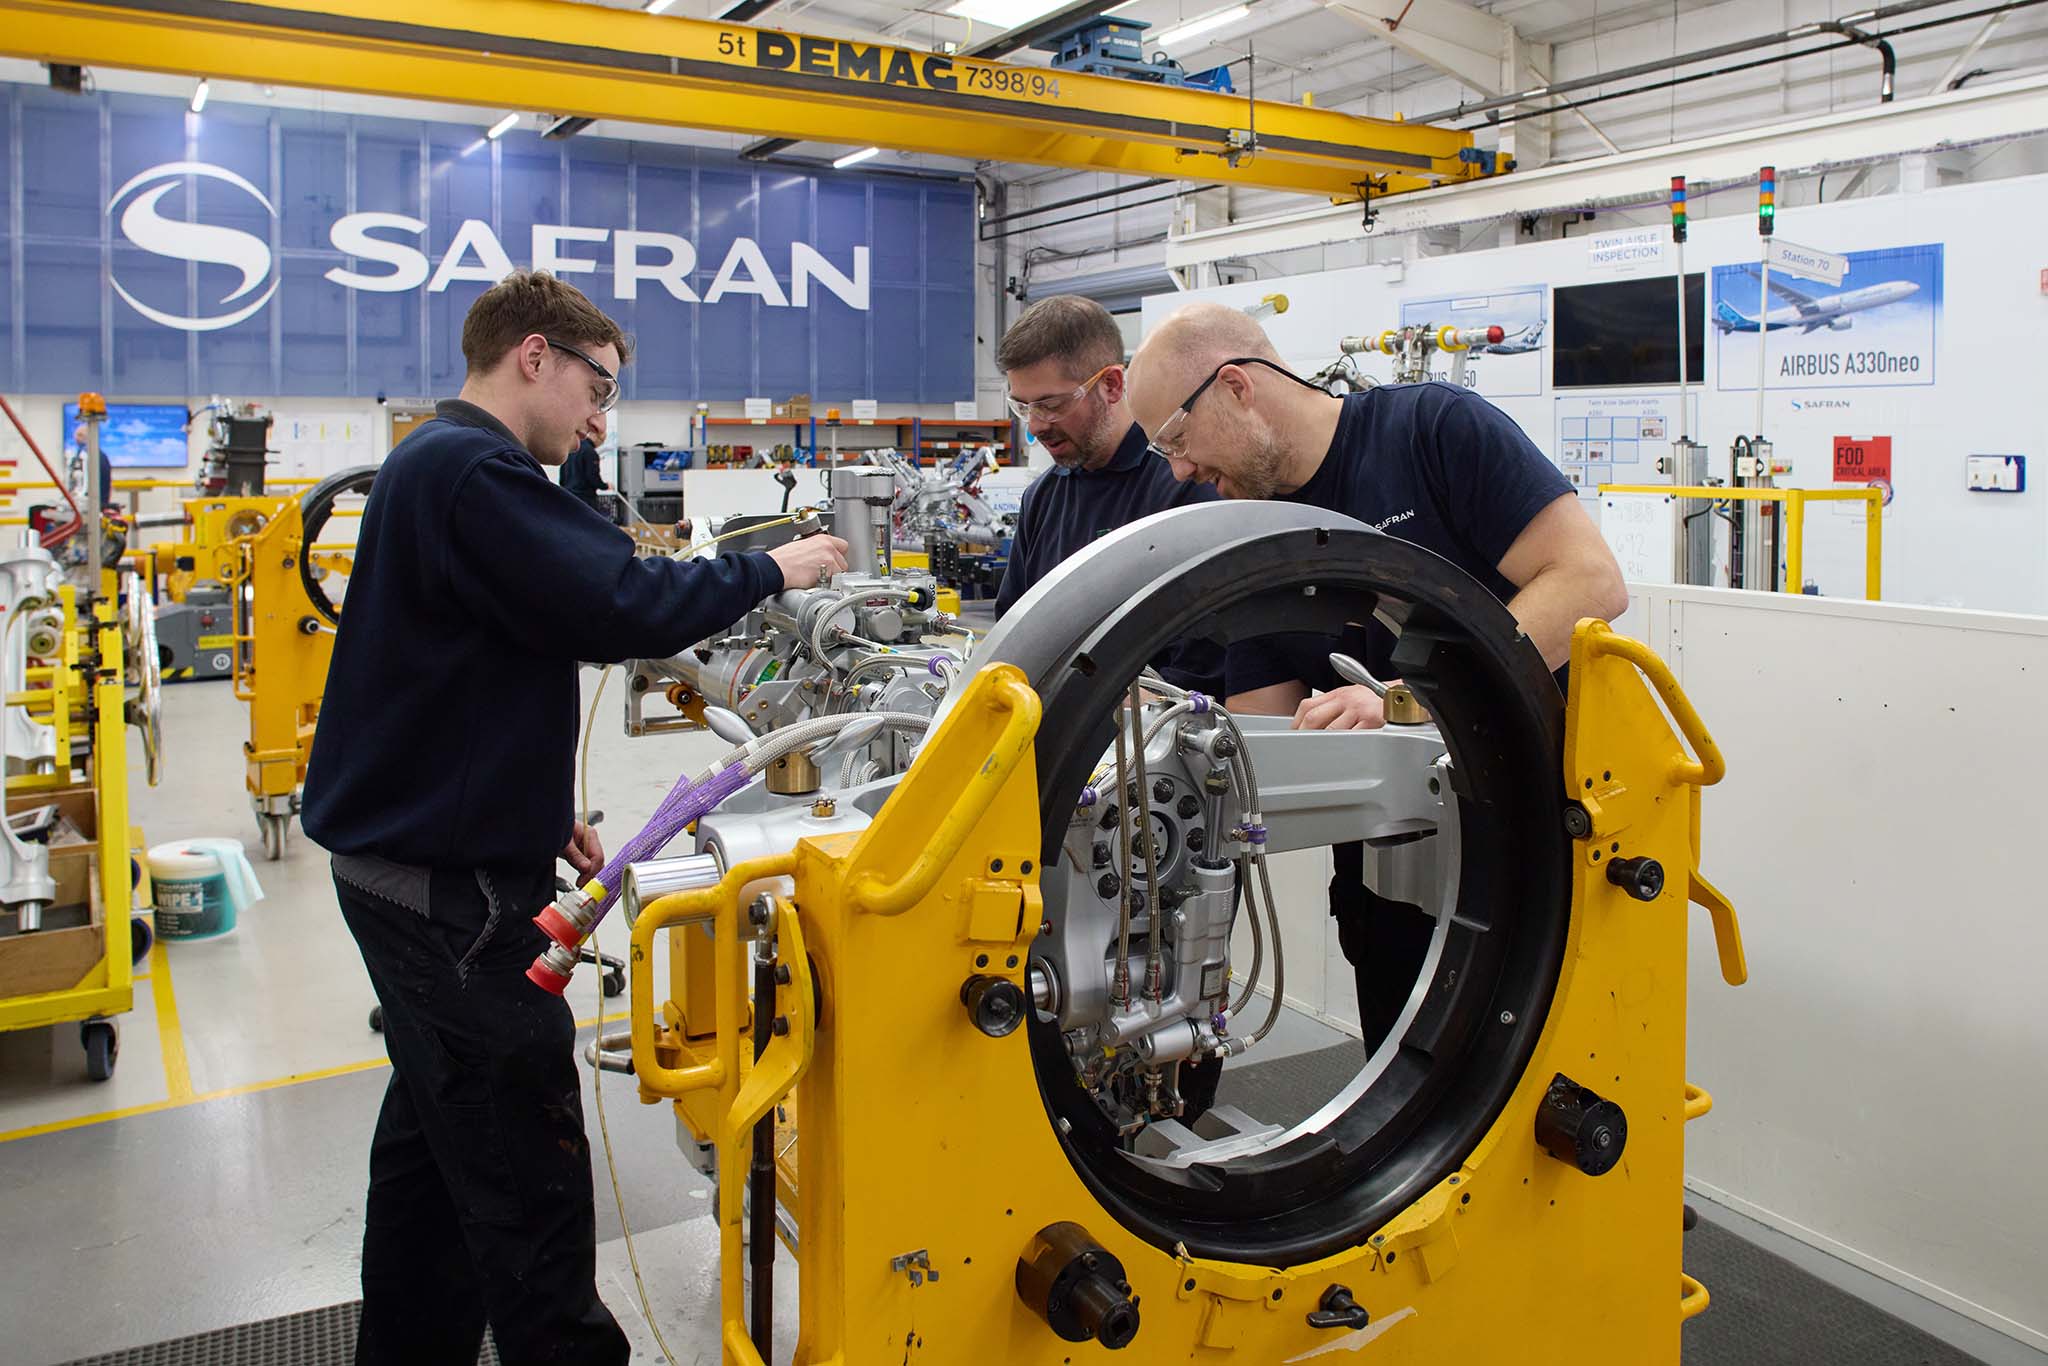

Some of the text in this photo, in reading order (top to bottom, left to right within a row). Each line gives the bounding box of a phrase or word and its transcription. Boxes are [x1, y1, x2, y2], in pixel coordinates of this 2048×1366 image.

[718, 31, 1060, 98] 5t DEMAG 7398/94
[1594, 238, 1623, 250] TWIN
[324, 212, 870, 311] SAFRAN
[1593, 247, 1658, 264] INSPECTION
[1782, 249, 1831, 272] Station 70
[1780, 350, 1919, 377] AIRBUS A330neo
[1804, 400, 1850, 409] SAFRAN
[1836, 447, 1864, 465] FOD
[1836, 466, 1887, 477] CRITICAL AREA
[1375, 509, 1415, 531] SAFRAN
